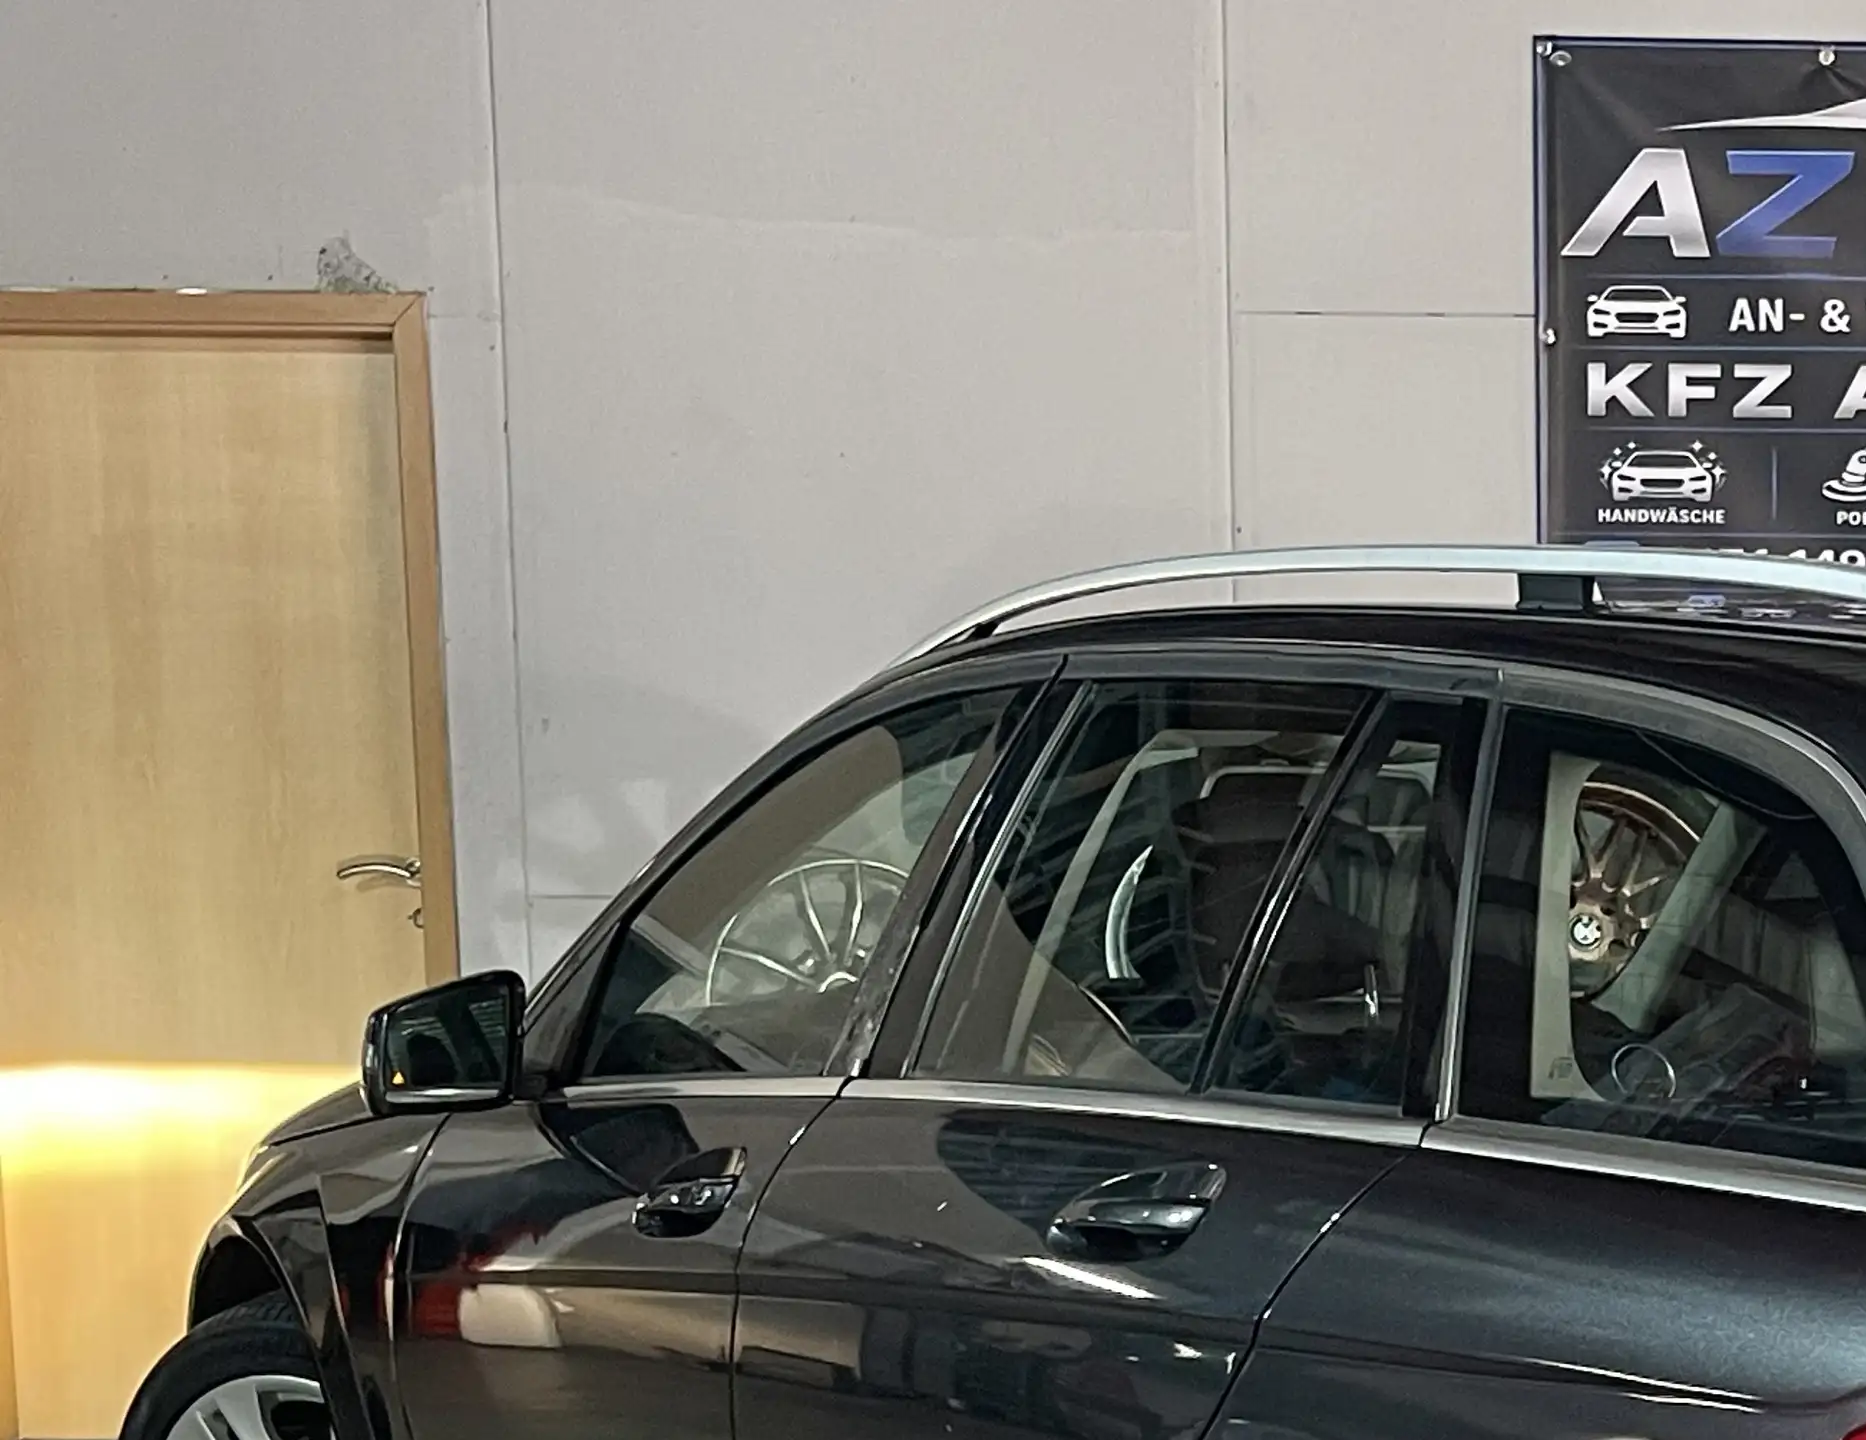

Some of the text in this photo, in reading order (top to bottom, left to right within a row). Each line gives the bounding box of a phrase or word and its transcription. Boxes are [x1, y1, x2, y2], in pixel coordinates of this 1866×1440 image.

[1561, 147, 1856, 258] AZ
[1729, 298, 1805, 332] AN-
[1820, 299, 1850, 333] &
[1587, 362, 1792, 418] KFZ
[1598, 507, 1726, 525] HANDWÄSCHE
